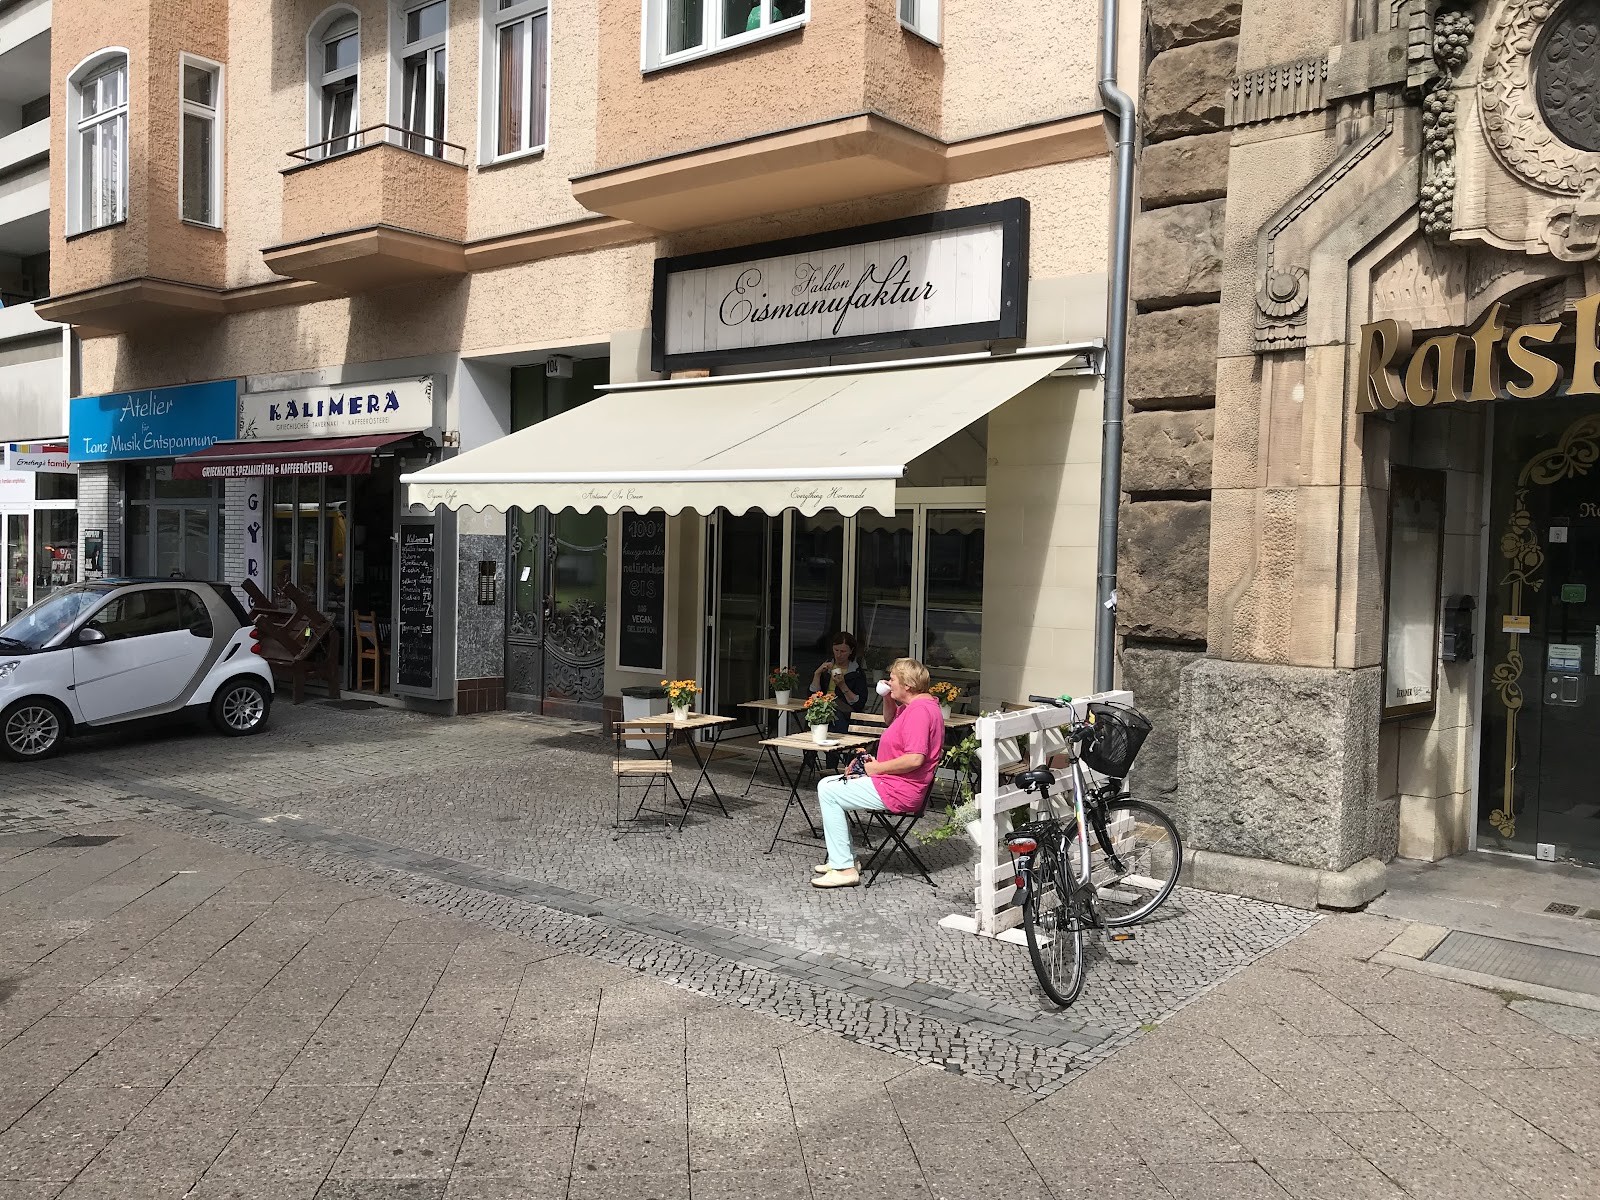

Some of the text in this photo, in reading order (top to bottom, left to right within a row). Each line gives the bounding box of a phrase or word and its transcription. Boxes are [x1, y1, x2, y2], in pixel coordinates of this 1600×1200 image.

[791, 262, 852, 296] Faldon
[719, 255, 938, 336] Eismanufaktur
[546, 359, 558, 374] 104
[119, 390, 174, 423] Atelier
[269, 389, 400, 422] KALIMERA
[141, 422, 150, 434] für
[276, 416, 390, 431] GRIECHISCHES TAVERNAKI KAFFEERÖSTEREI
[83, 437, 108, 454] Tanz
[110, 432, 141, 455] Musik
[47, 458, 72, 469] family
[201, 460, 328, 478] GRIECHISCHE SPEZIALITÄTEN KAFFEERÖSTEREI
[790, 487, 867, 508] Everything Homemade
[632, 614, 653, 624] VEGAN
[626, 625, 658, 635] SELECTION
